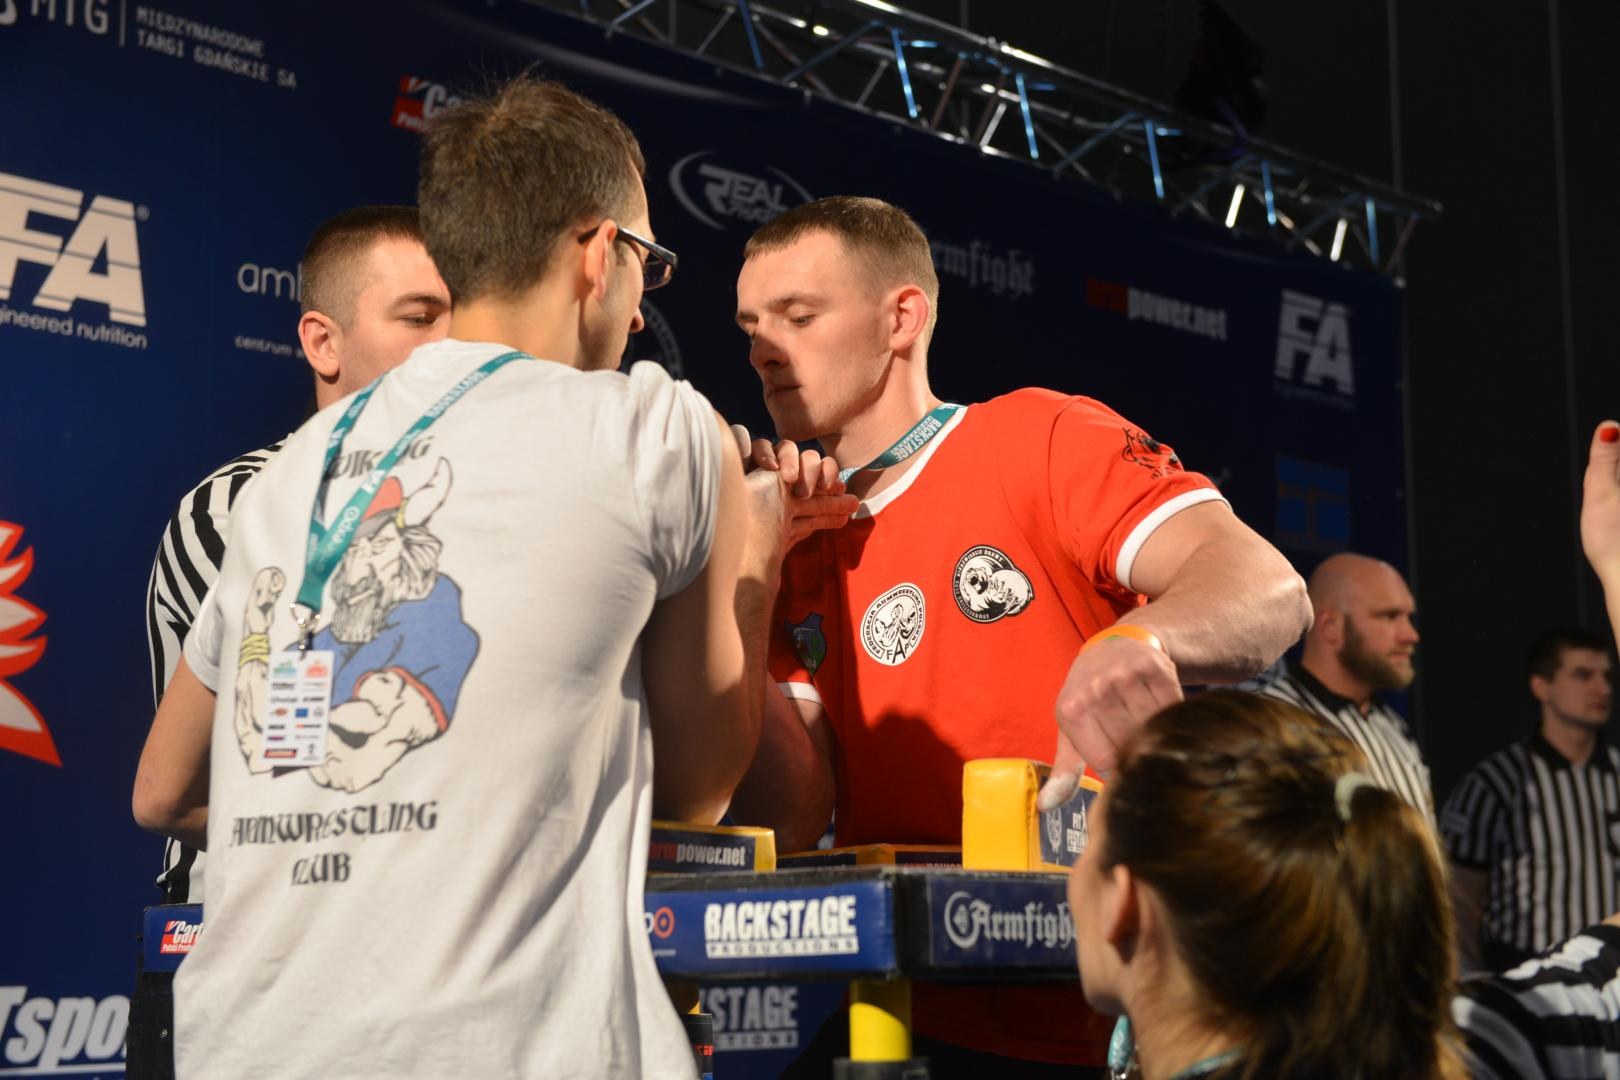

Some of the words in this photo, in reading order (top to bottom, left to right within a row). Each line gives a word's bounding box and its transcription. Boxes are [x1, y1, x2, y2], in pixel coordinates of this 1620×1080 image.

[137, 28, 184, 58] TARGI
[277, 68, 297, 89] SA
[76, 321, 148, 350] nutrition
[235, 334, 292, 357] centrum
[1274, 288, 1356, 396] FA
[325, 436, 435, 481] VIKG
[886, 636, 910, 664] FAP
[704, 894, 857, 942] BACKSTAGE
[707, 937, 858, 957] PRODUCTIONS
[0, 985, 130, 1071] Tspo
